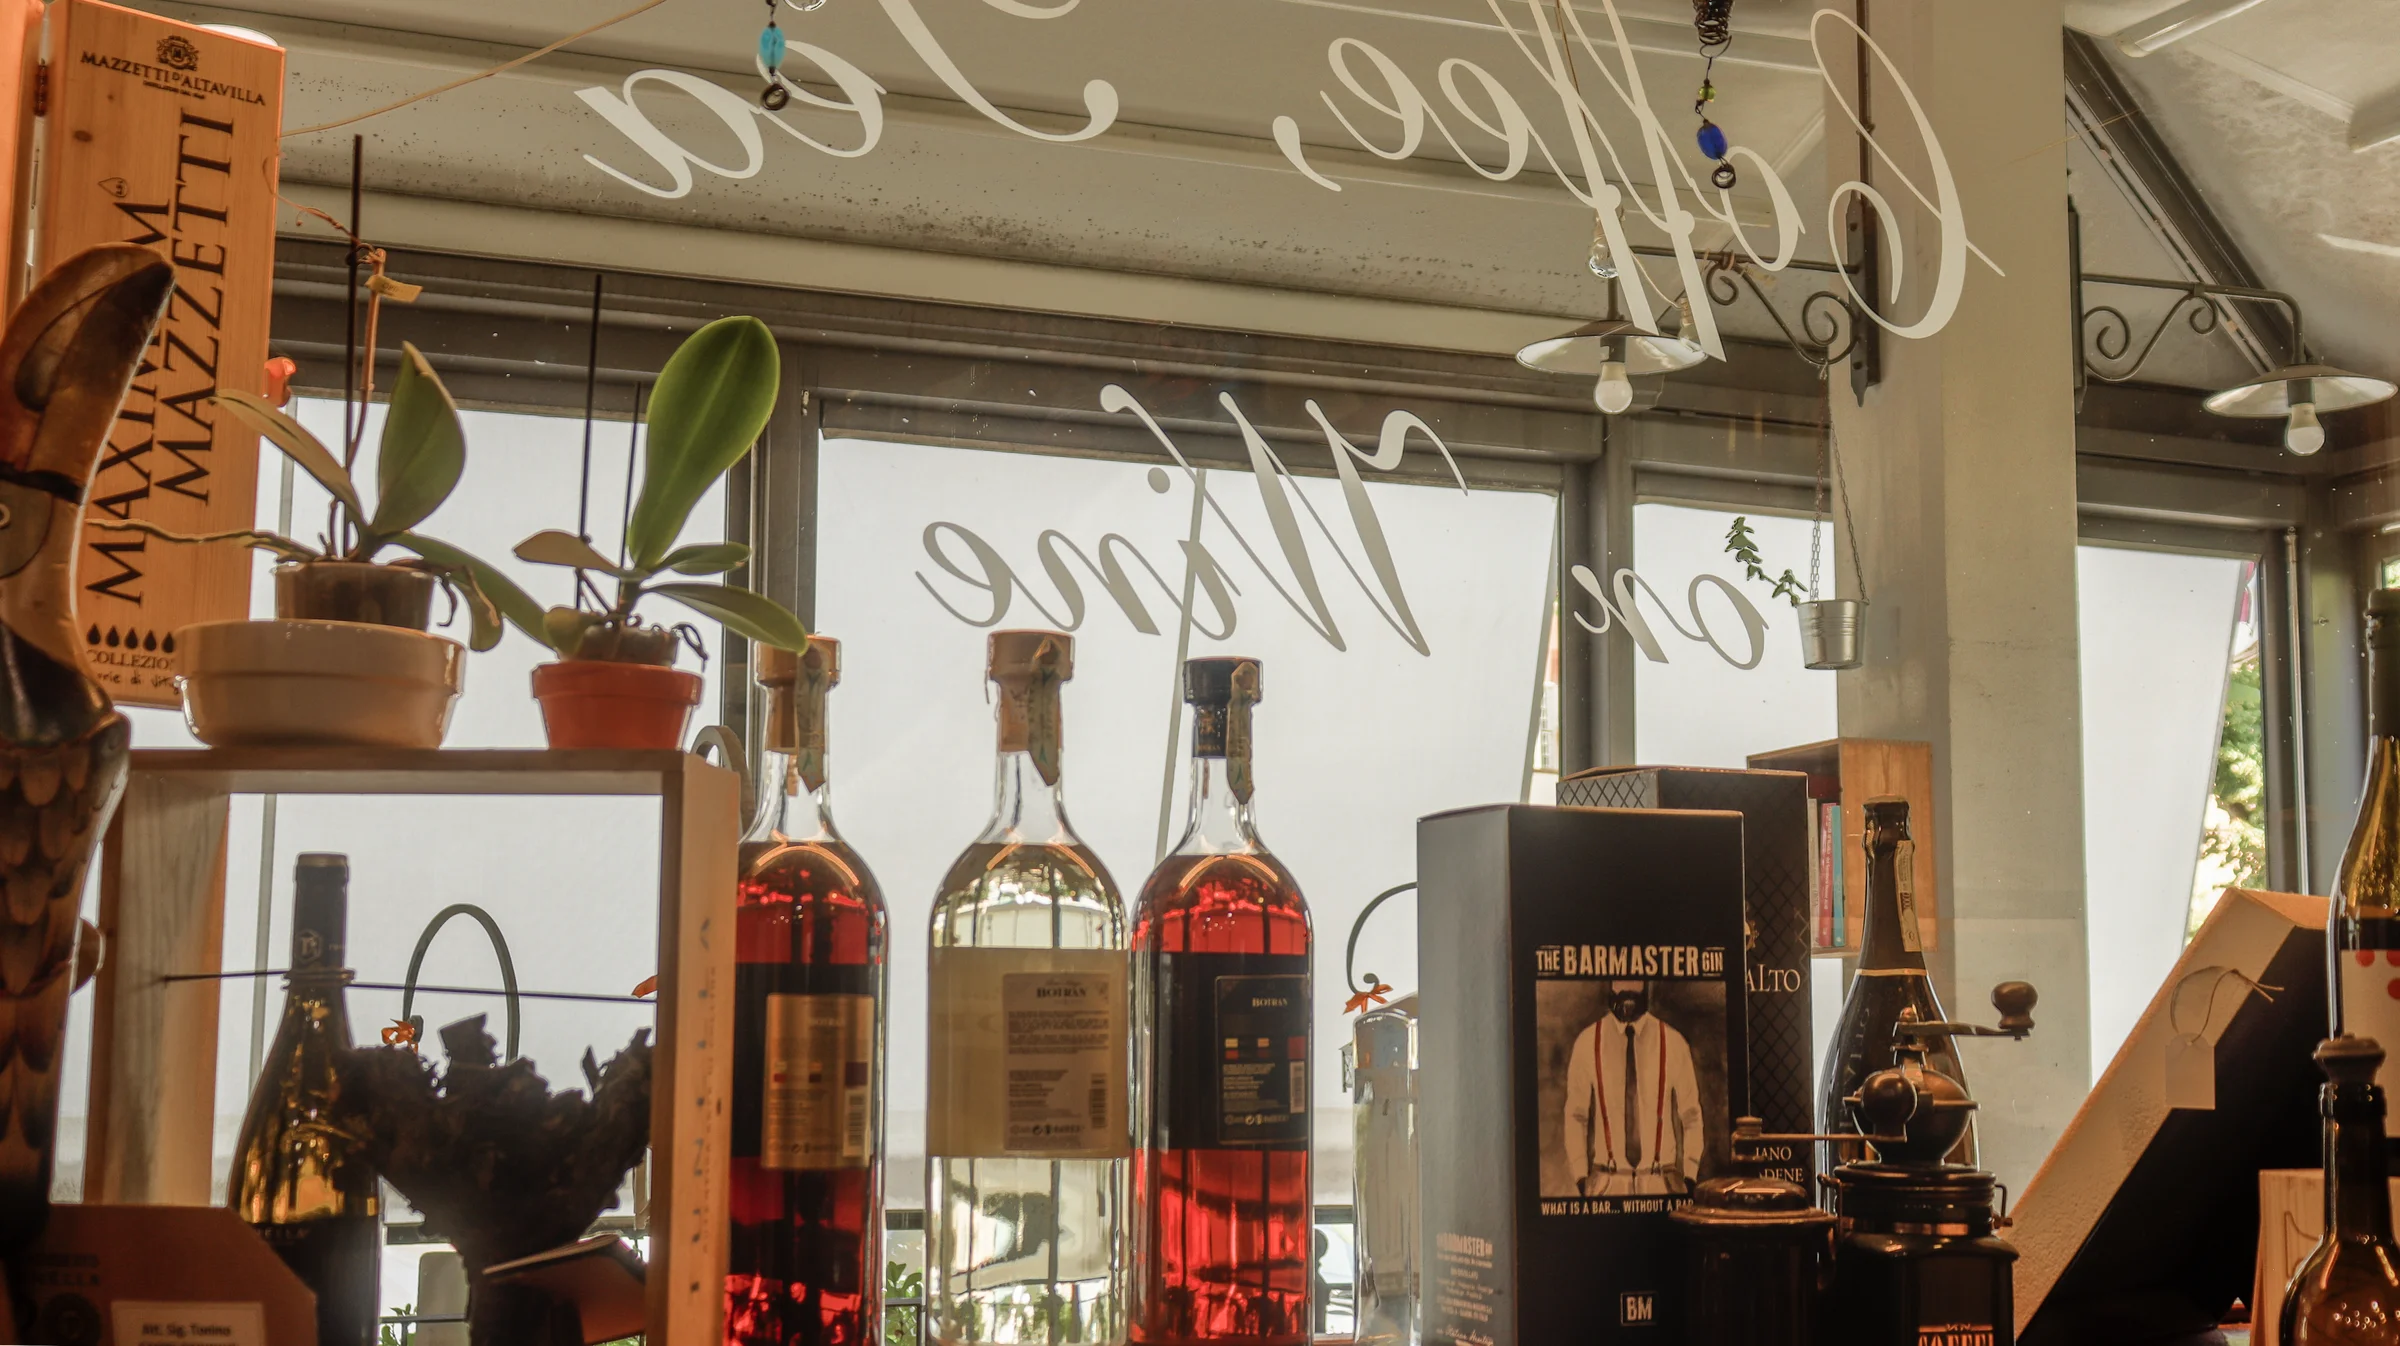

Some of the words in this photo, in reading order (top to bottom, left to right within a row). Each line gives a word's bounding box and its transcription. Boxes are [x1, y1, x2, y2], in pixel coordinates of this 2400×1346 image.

[80, 51, 170, 83] MAZZETTI
[171, 71, 266, 106] D'ALTAVILLA
[154, 107, 234, 506] MAZZETTI
[85, 198, 171, 608] MAXIM
[1536, 950, 1560, 971] THE
[1563, 944, 1700, 977] BARMASTER
[1702, 952, 1724, 973] GIN
[1760, 1168, 1804, 1182] DENE
[1541, 1201, 1567, 1216] WHAT
[1570, 1201, 1580, 1215] IS
[1583, 1201, 1590, 1215] A
[1592, 1200, 1621, 1214] BAR...
[1623, 1199, 1663, 1213] WITHOUT
[1666, 1199, 1673, 1212] A
[1626, 1295, 1653, 1321] BM
